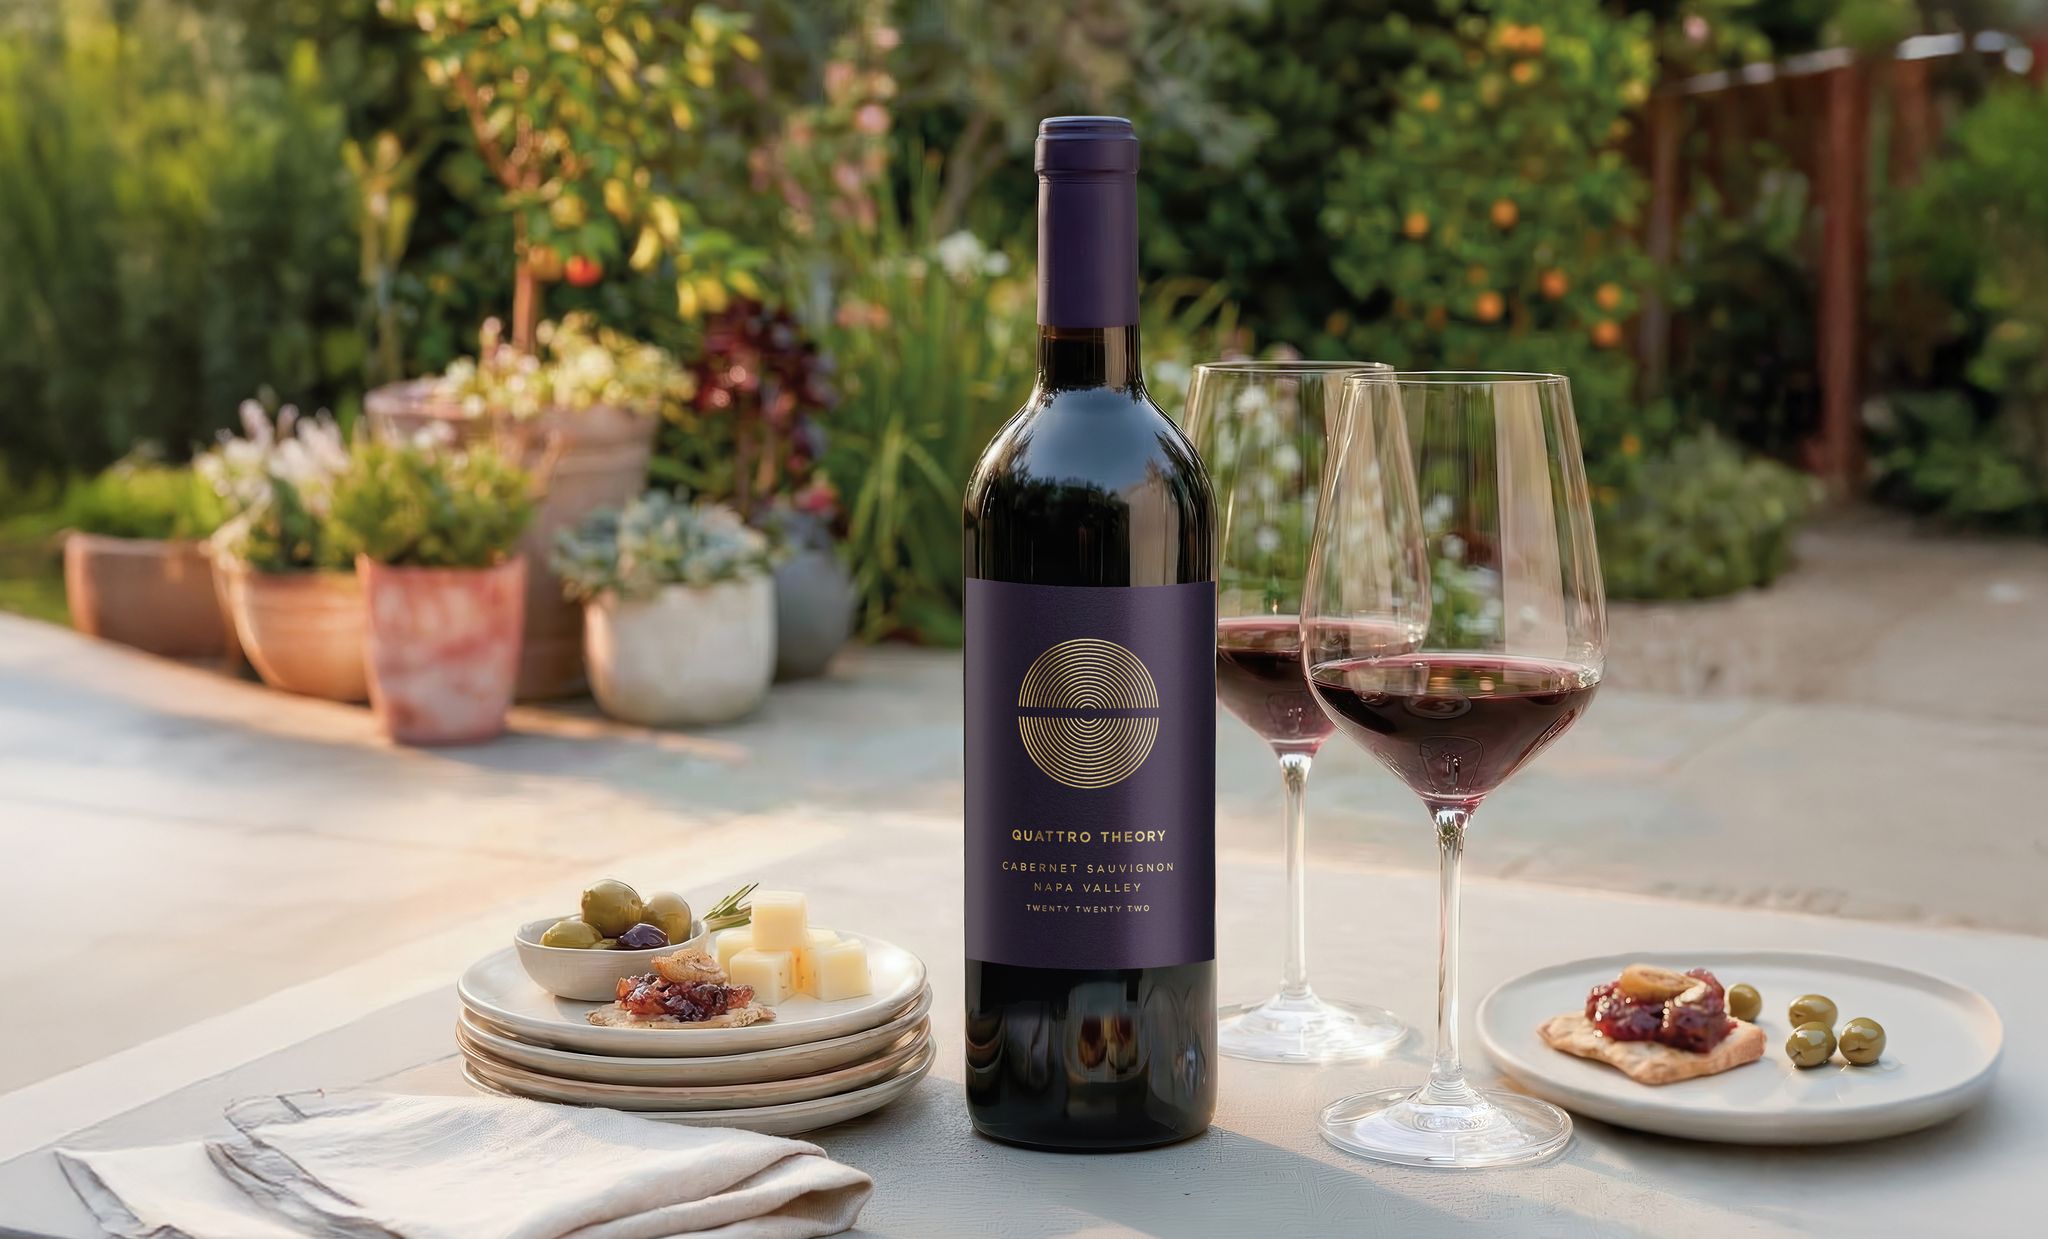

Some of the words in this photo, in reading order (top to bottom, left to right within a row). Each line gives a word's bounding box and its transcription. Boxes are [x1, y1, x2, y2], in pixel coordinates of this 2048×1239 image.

[1011, 829, 1091, 843] QUATTRO
[1100, 830, 1166, 843] THEORY
[1002, 861, 1078, 873] CABERNET
[1086, 862, 1175, 873] SAUVIGNON
[1033, 882, 1073, 892] NAPA
[1082, 882, 1142, 893] VALLEY
[1025, 904, 1070, 912] TWENTY
[1075, 905, 1122, 913] TWENTY
[1127, 904, 1151, 912] TWO
